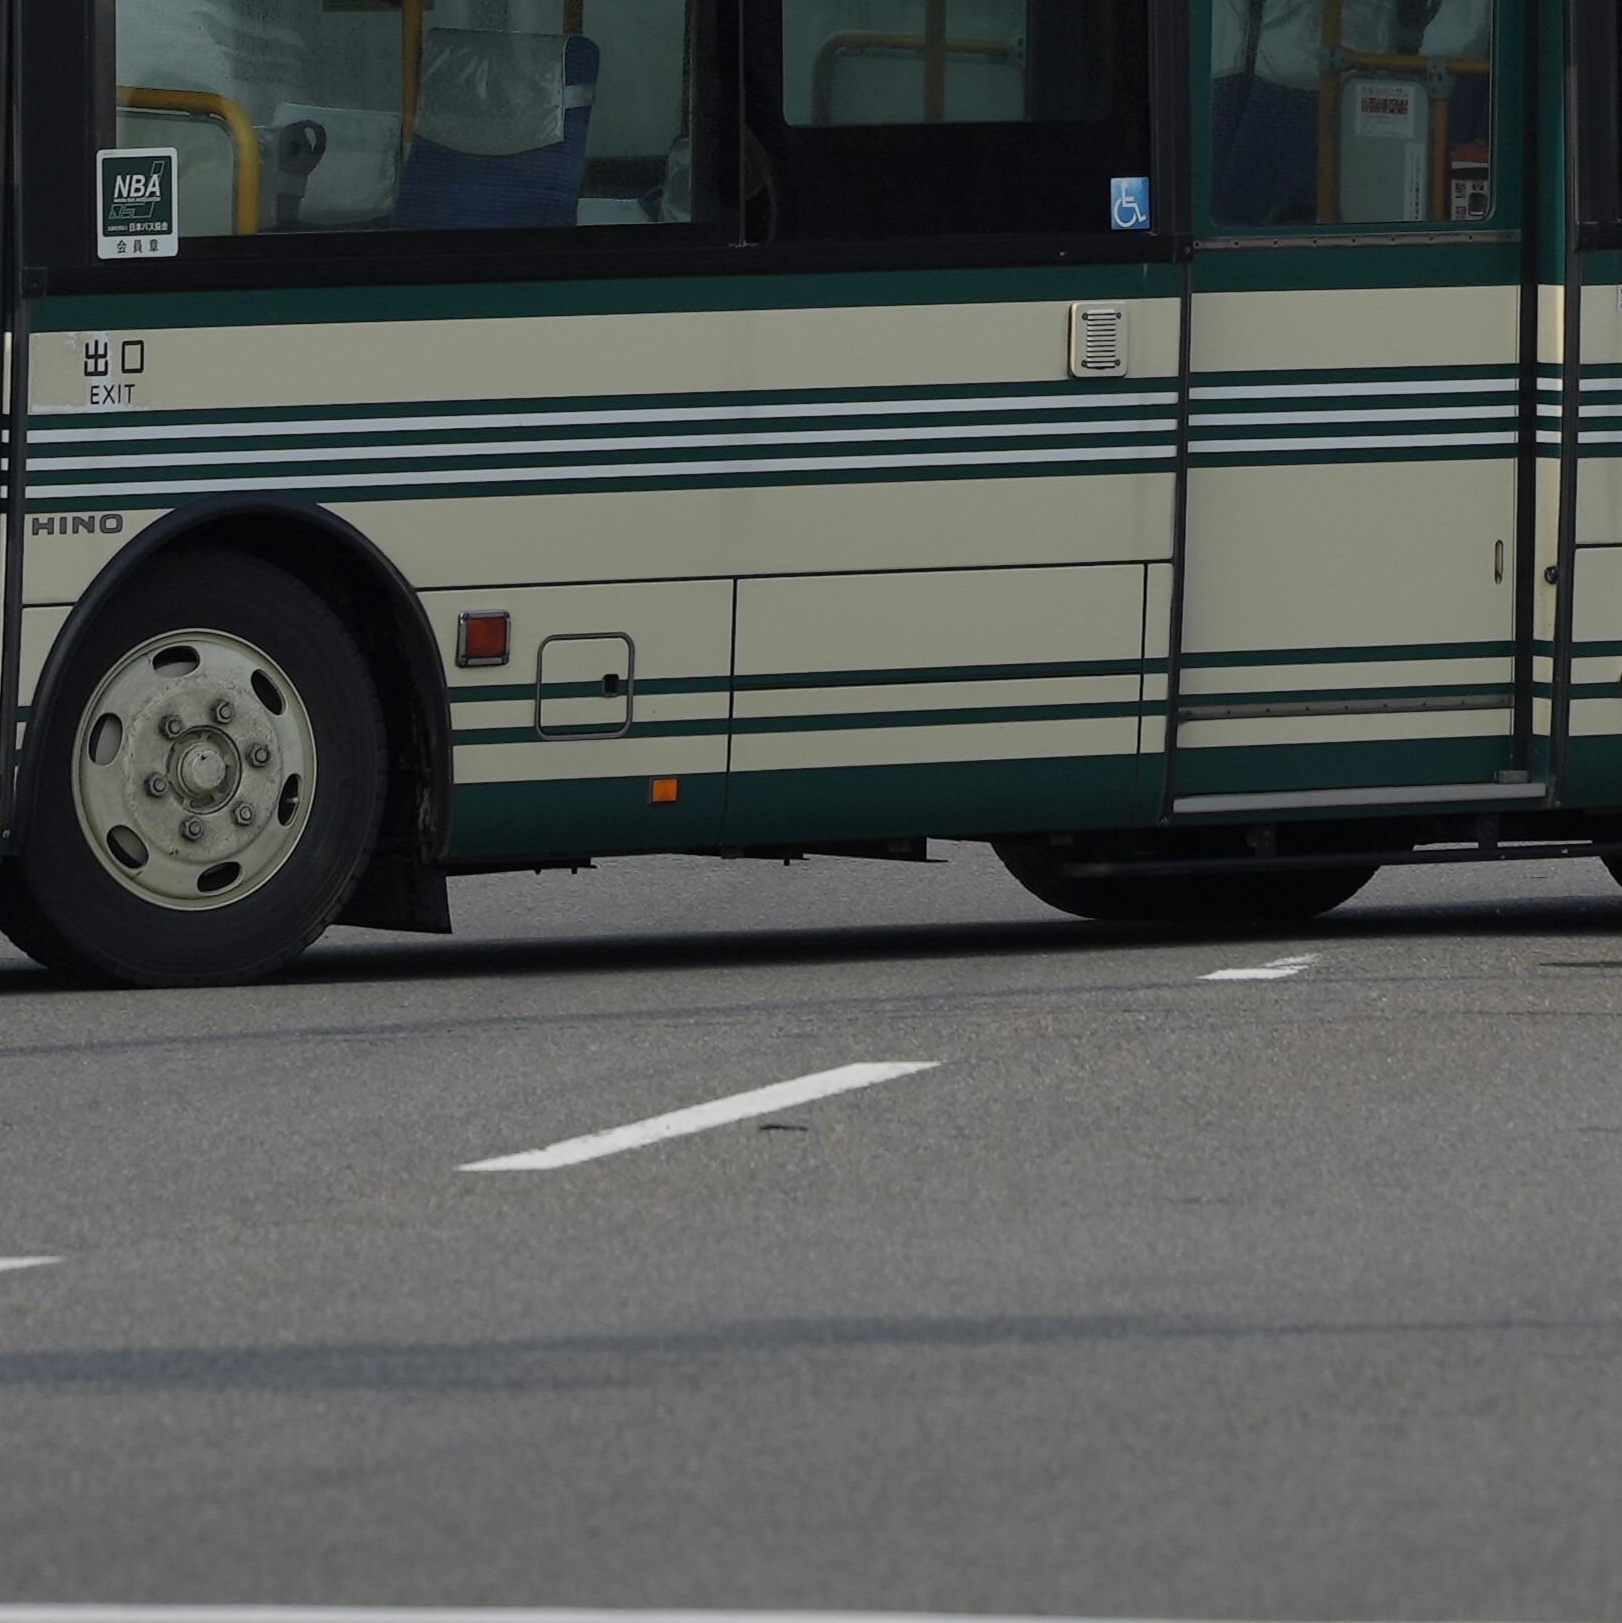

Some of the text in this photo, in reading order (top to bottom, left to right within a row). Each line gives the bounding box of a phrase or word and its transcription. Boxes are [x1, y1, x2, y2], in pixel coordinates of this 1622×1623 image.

[113, 174, 161, 198] NBA
[117, 239, 159, 254] 会員章
[84, 339, 144, 377] 出口
[90, 384, 135, 405] EXIT
[32, 514, 124, 536] HINO
